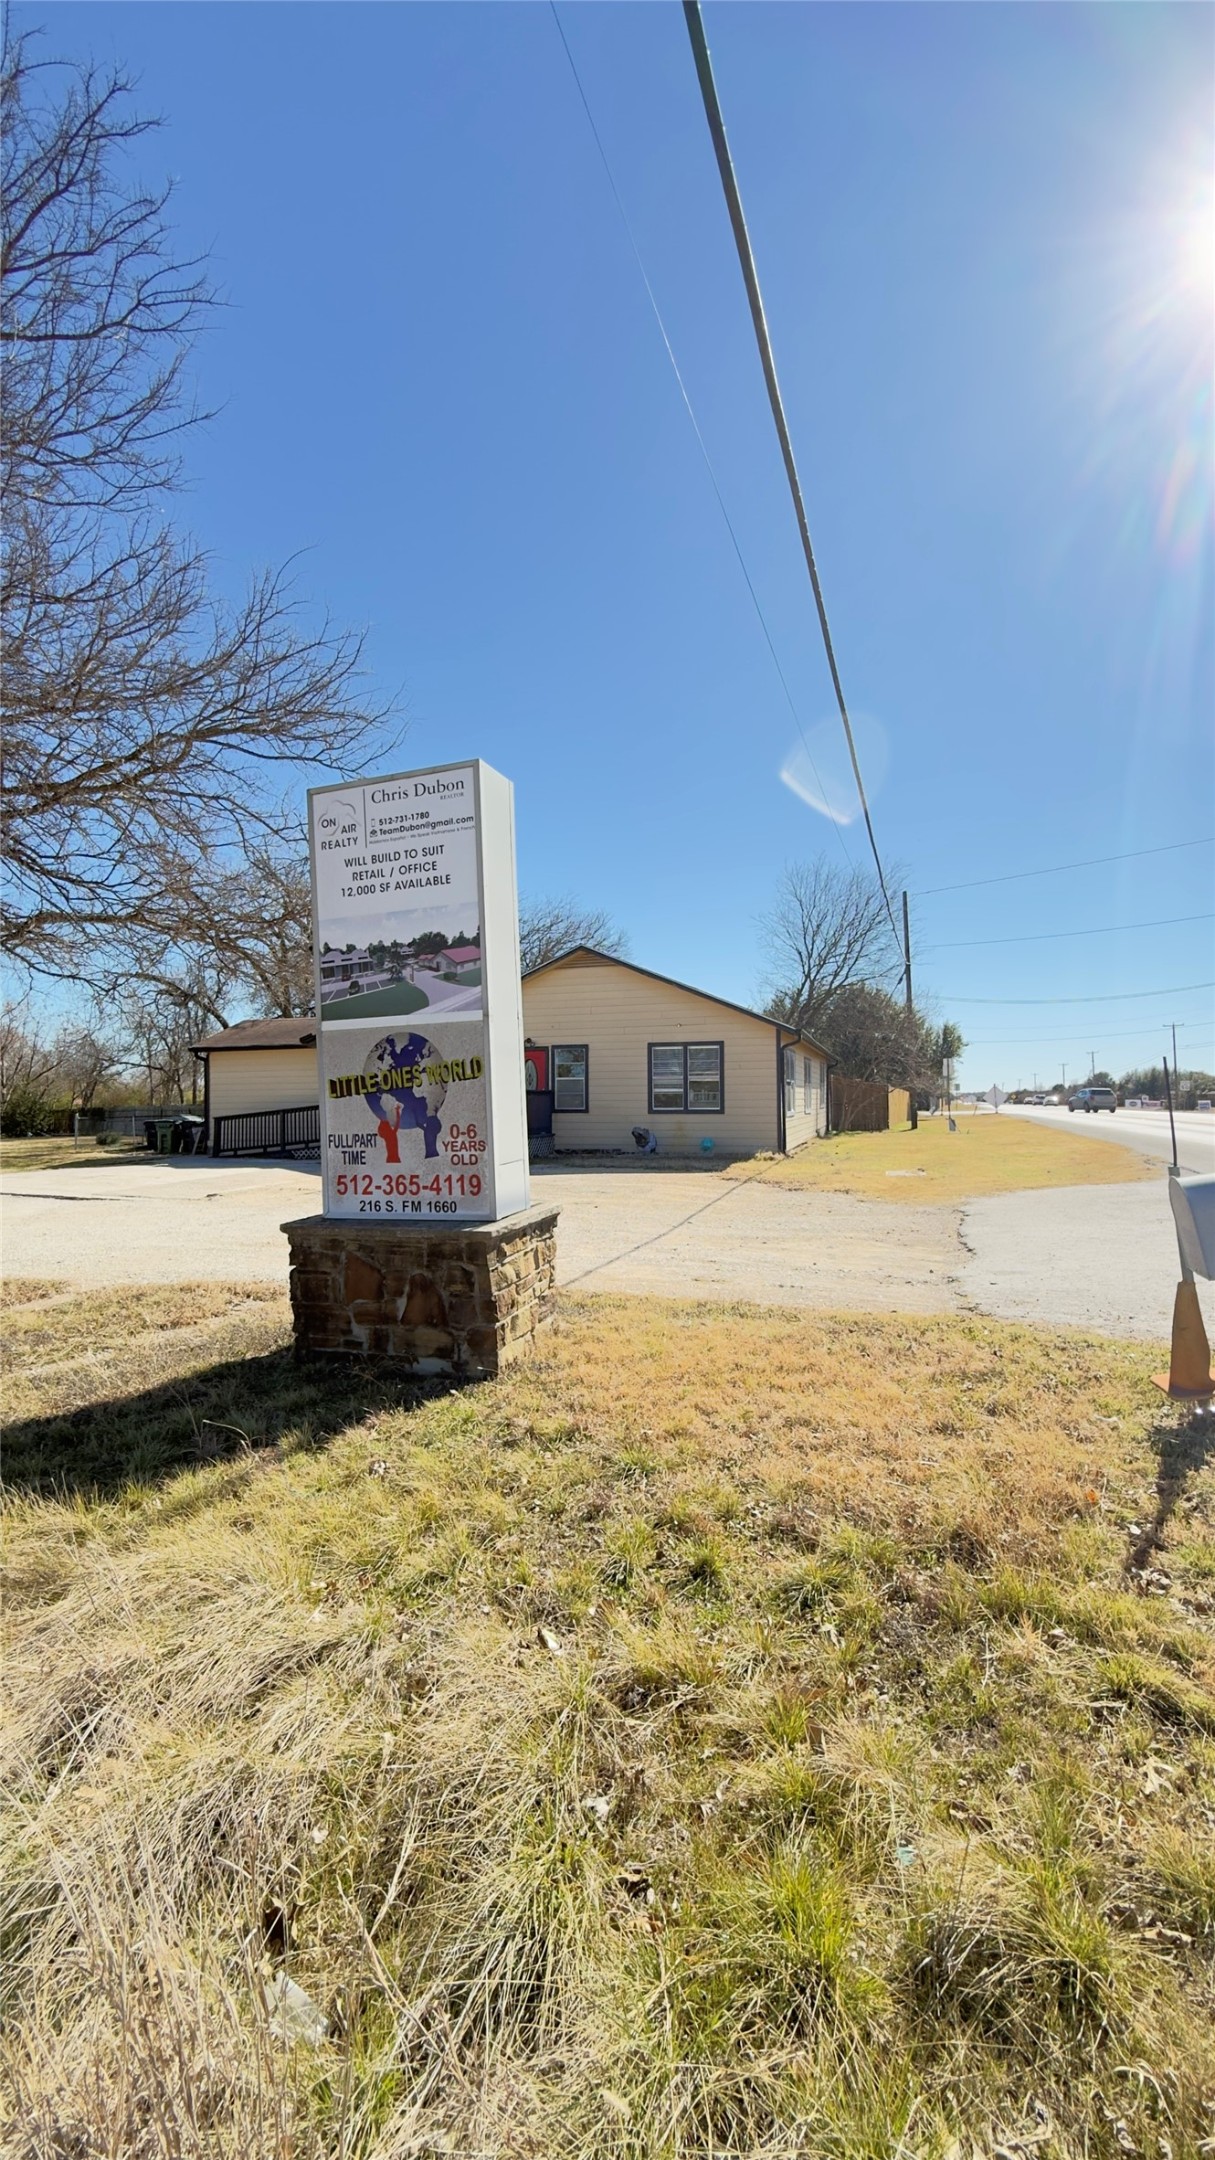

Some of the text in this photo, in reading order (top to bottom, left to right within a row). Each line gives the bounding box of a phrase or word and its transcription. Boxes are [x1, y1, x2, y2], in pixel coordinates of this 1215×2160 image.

[371, 779, 464, 804] Chris Dubon
[321, 817, 336, 829] ON
[378, 811, 430, 826] 512-731-1780
[379, 816, 474, 836] TeamDubon@gmail.com
[341, 824, 357, 834] AIR
[321, 837, 358, 850] REALTY
[344, 844, 444, 868] WILL BUILD TO SUIT
[352, 860, 438, 881] RETAIL / OFFICE
[380, 881, 391, 892] SF
[394, 874, 452, 891] AVAILABLE
[327, 1055, 484, 1100] LITTLE ONES WORLD
[328, 1132, 378, 1148] FULL/PART
[450, 1124, 478, 1140] 0-6
[442, 1140, 486, 1152] YEARS
[342, 1150, 366, 1166] TIME
[450, 1154, 478, 1166] OLD
[336, 1174, 482, 1196] 512-365-4119
[360, 1200, 458, 1213] 216 S. FM 1660
